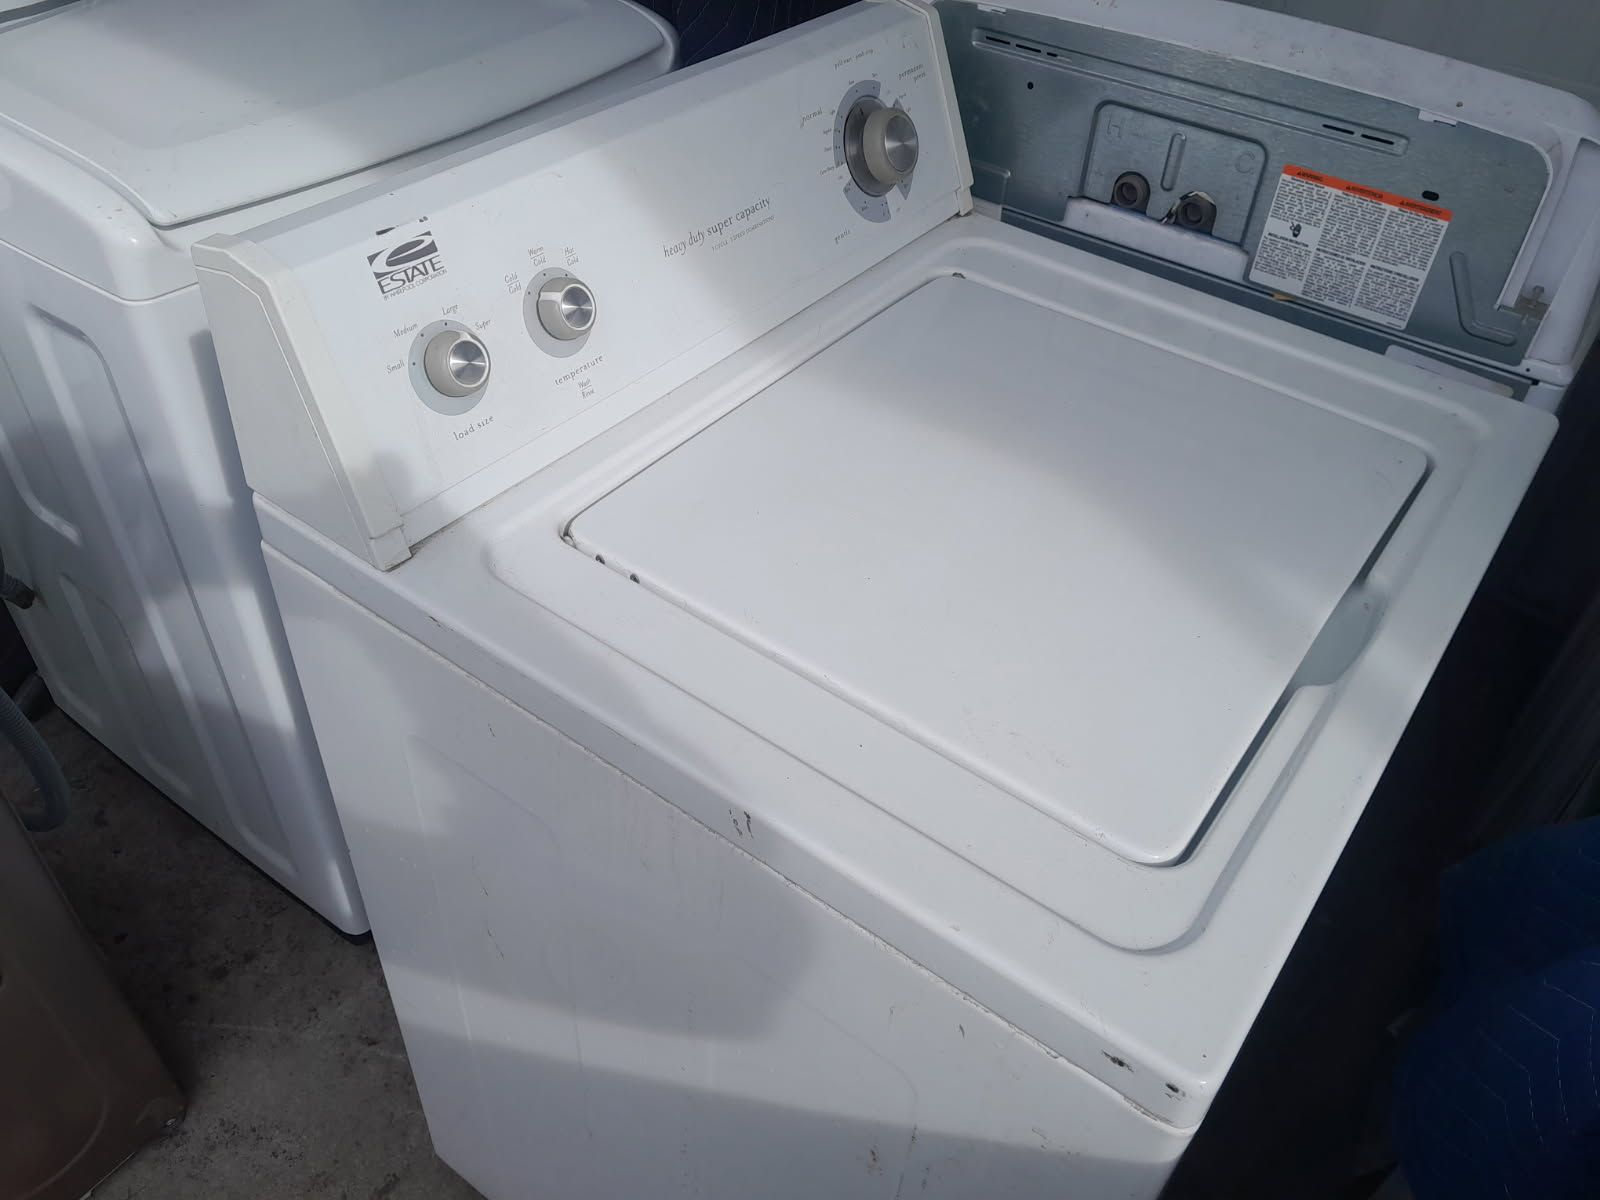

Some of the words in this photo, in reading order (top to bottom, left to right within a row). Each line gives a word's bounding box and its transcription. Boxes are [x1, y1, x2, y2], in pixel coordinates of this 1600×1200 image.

[800, 106, 823, 128] normal
[663, 240, 687, 258] heavy
[688, 229, 705, 247] duty
[707, 216, 733, 236] super
[735, 197, 770, 221] capacity
[527, 246, 544, 256] Warm
[564, 247, 575, 256] Hot
[533, 255, 547, 267] Cold
[566, 256, 579, 266] Cold
[377, 254, 445, 295] ESTATE
[504, 272, 518, 283] Cold
[508, 282, 522, 294] Cold
[441, 304, 459, 316] Large
[393, 323, 419, 338] Medium
[474, 319, 491, 330] Super
[386, 360, 405, 374] Small
[554, 355, 603, 386] temperature
[453, 423, 475, 441] load
[477, 416, 494, 429] size
